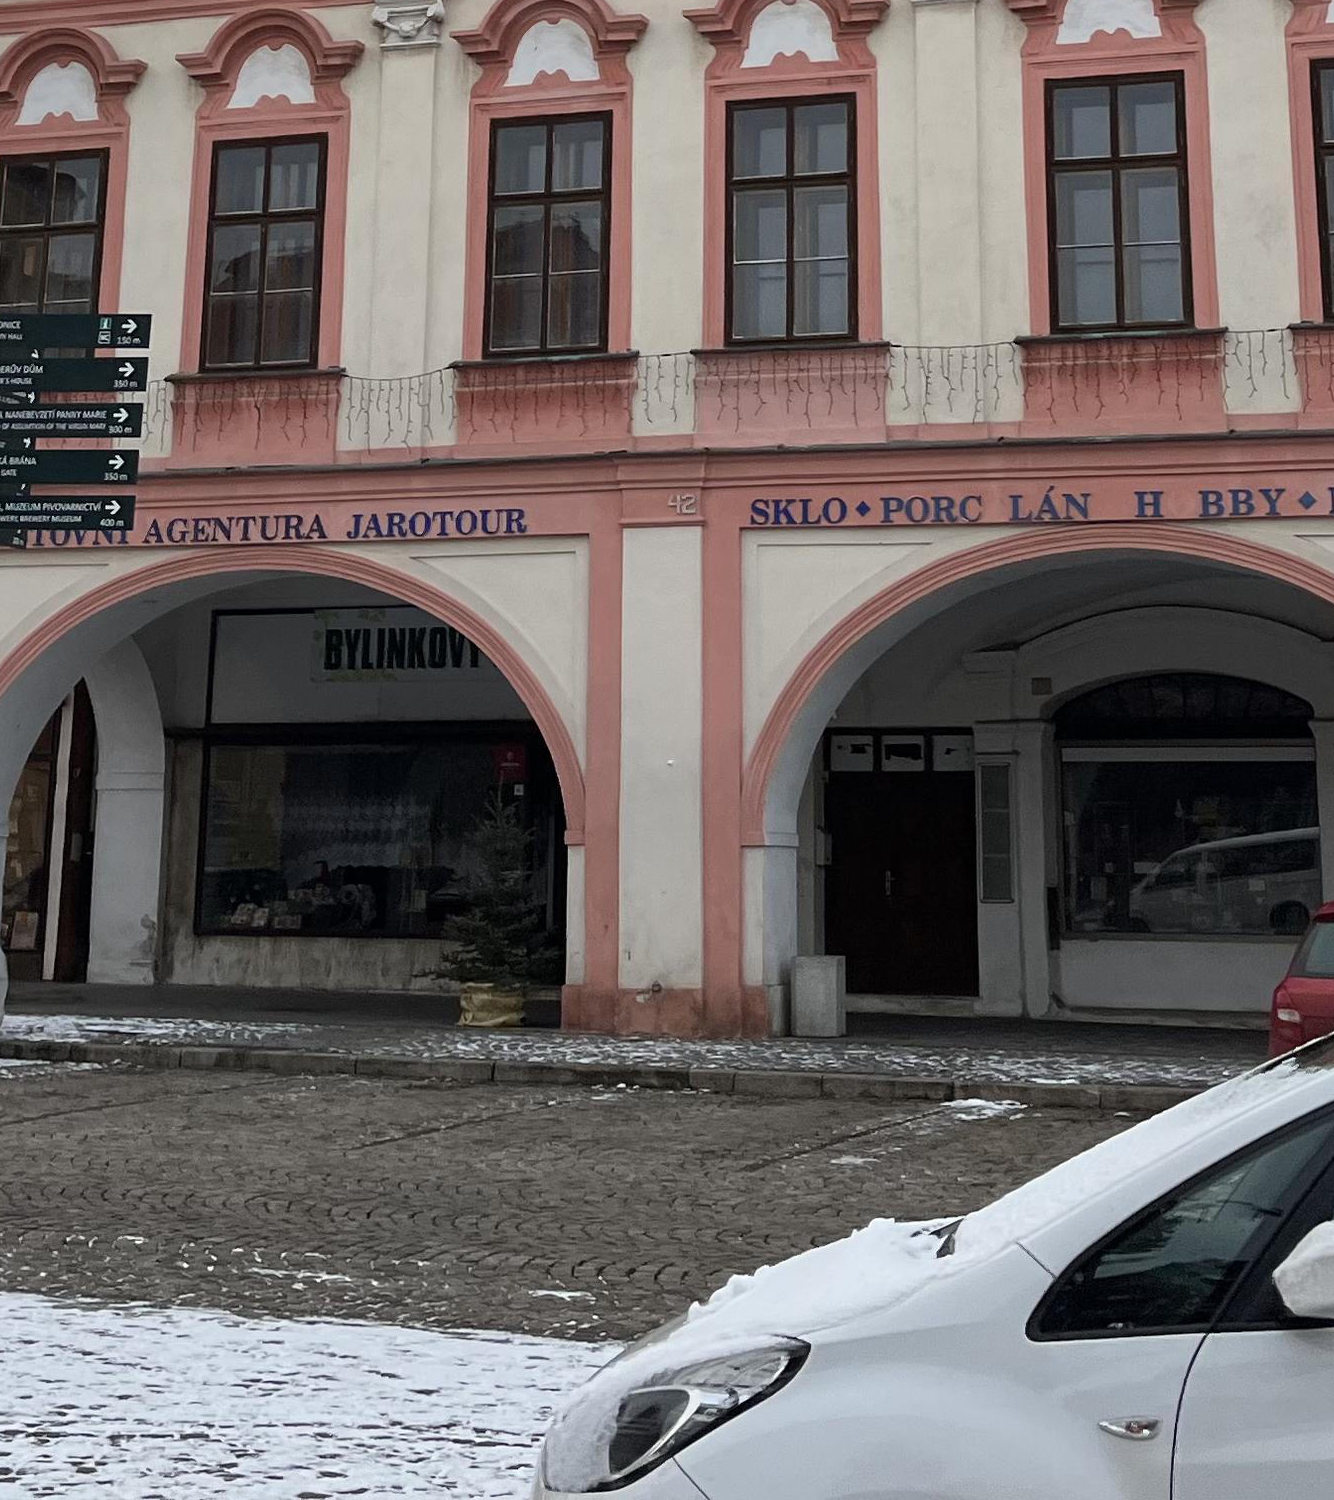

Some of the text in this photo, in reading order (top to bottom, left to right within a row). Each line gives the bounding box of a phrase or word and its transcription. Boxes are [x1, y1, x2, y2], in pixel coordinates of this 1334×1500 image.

[23, 363, 43, 374] DŮM
[5, 409, 56, 419] NANEBEVZETÍ
[56, 410, 81, 419] PANNY
[82, 410, 107, 419] MARIE
[9, 454, 37, 465] BRÁNA
[4, 502, 41, 511] MUZEUM
[42, 501, 102, 511] PIVOVARNICTVÍ
[667, 494, 697, 514] 42
[750, 497, 848, 526] SKLO
[880, 494, 983, 523] PORC
[1009, 485, 1090, 521] LÁN
[1134, 490, 1165, 518] H
[1198, 487, 1287, 516] BBY
[142, 514, 329, 545] AGENTURA
[346, 508, 529, 538] JAROTOUR
